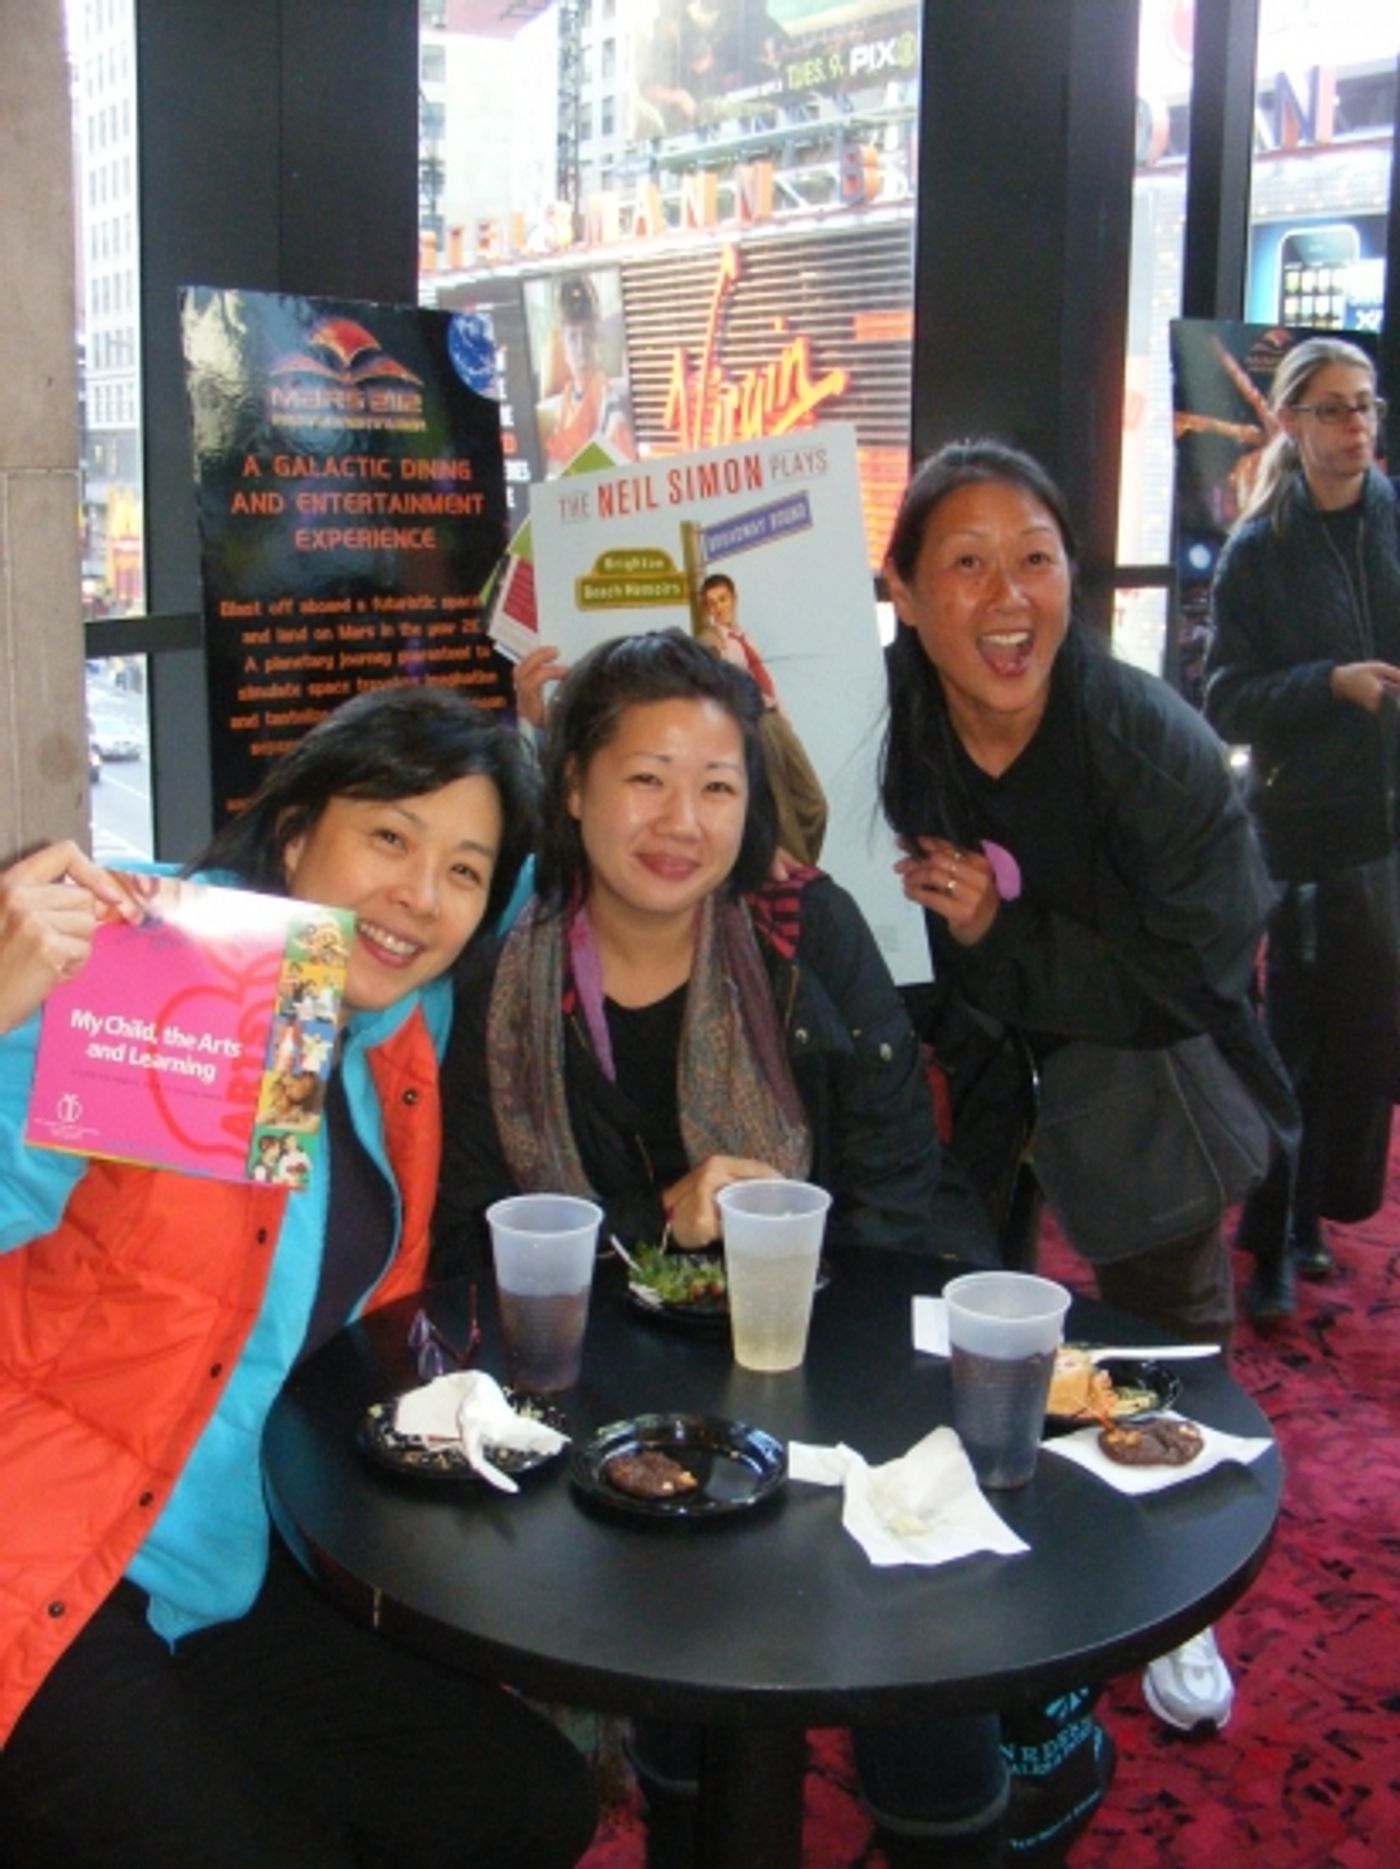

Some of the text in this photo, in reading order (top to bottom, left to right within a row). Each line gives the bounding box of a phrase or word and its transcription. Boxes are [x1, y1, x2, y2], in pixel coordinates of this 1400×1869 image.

[243, 456, 472, 481] A GALACTIC DINING
[559, 449, 829, 520] THE NEIL SIMON PLAYS
[231, 492, 485, 516] AND ENTERTAINMENT
[295, 527, 437, 549] EXPERIENCE
[604, 555, 665, 574] Brighton
[220, 600, 261, 618] Blast
[268, 598, 293, 616] off
[300, 598, 350, 614] aboard
[242, 629, 270, 645] and
[276, 627, 307, 644] land
[313, 628, 333, 642] on
[338, 624, 375, 640] Mars
[400, 621, 422, 637] the
[244, 655, 258, 674] A
[340, 651, 391, 669] journey
[71, 1009, 241, 1059] My Child, the Arts
[86, 1040, 125, 1062] and
[129, 1044, 217, 1085] Learning
